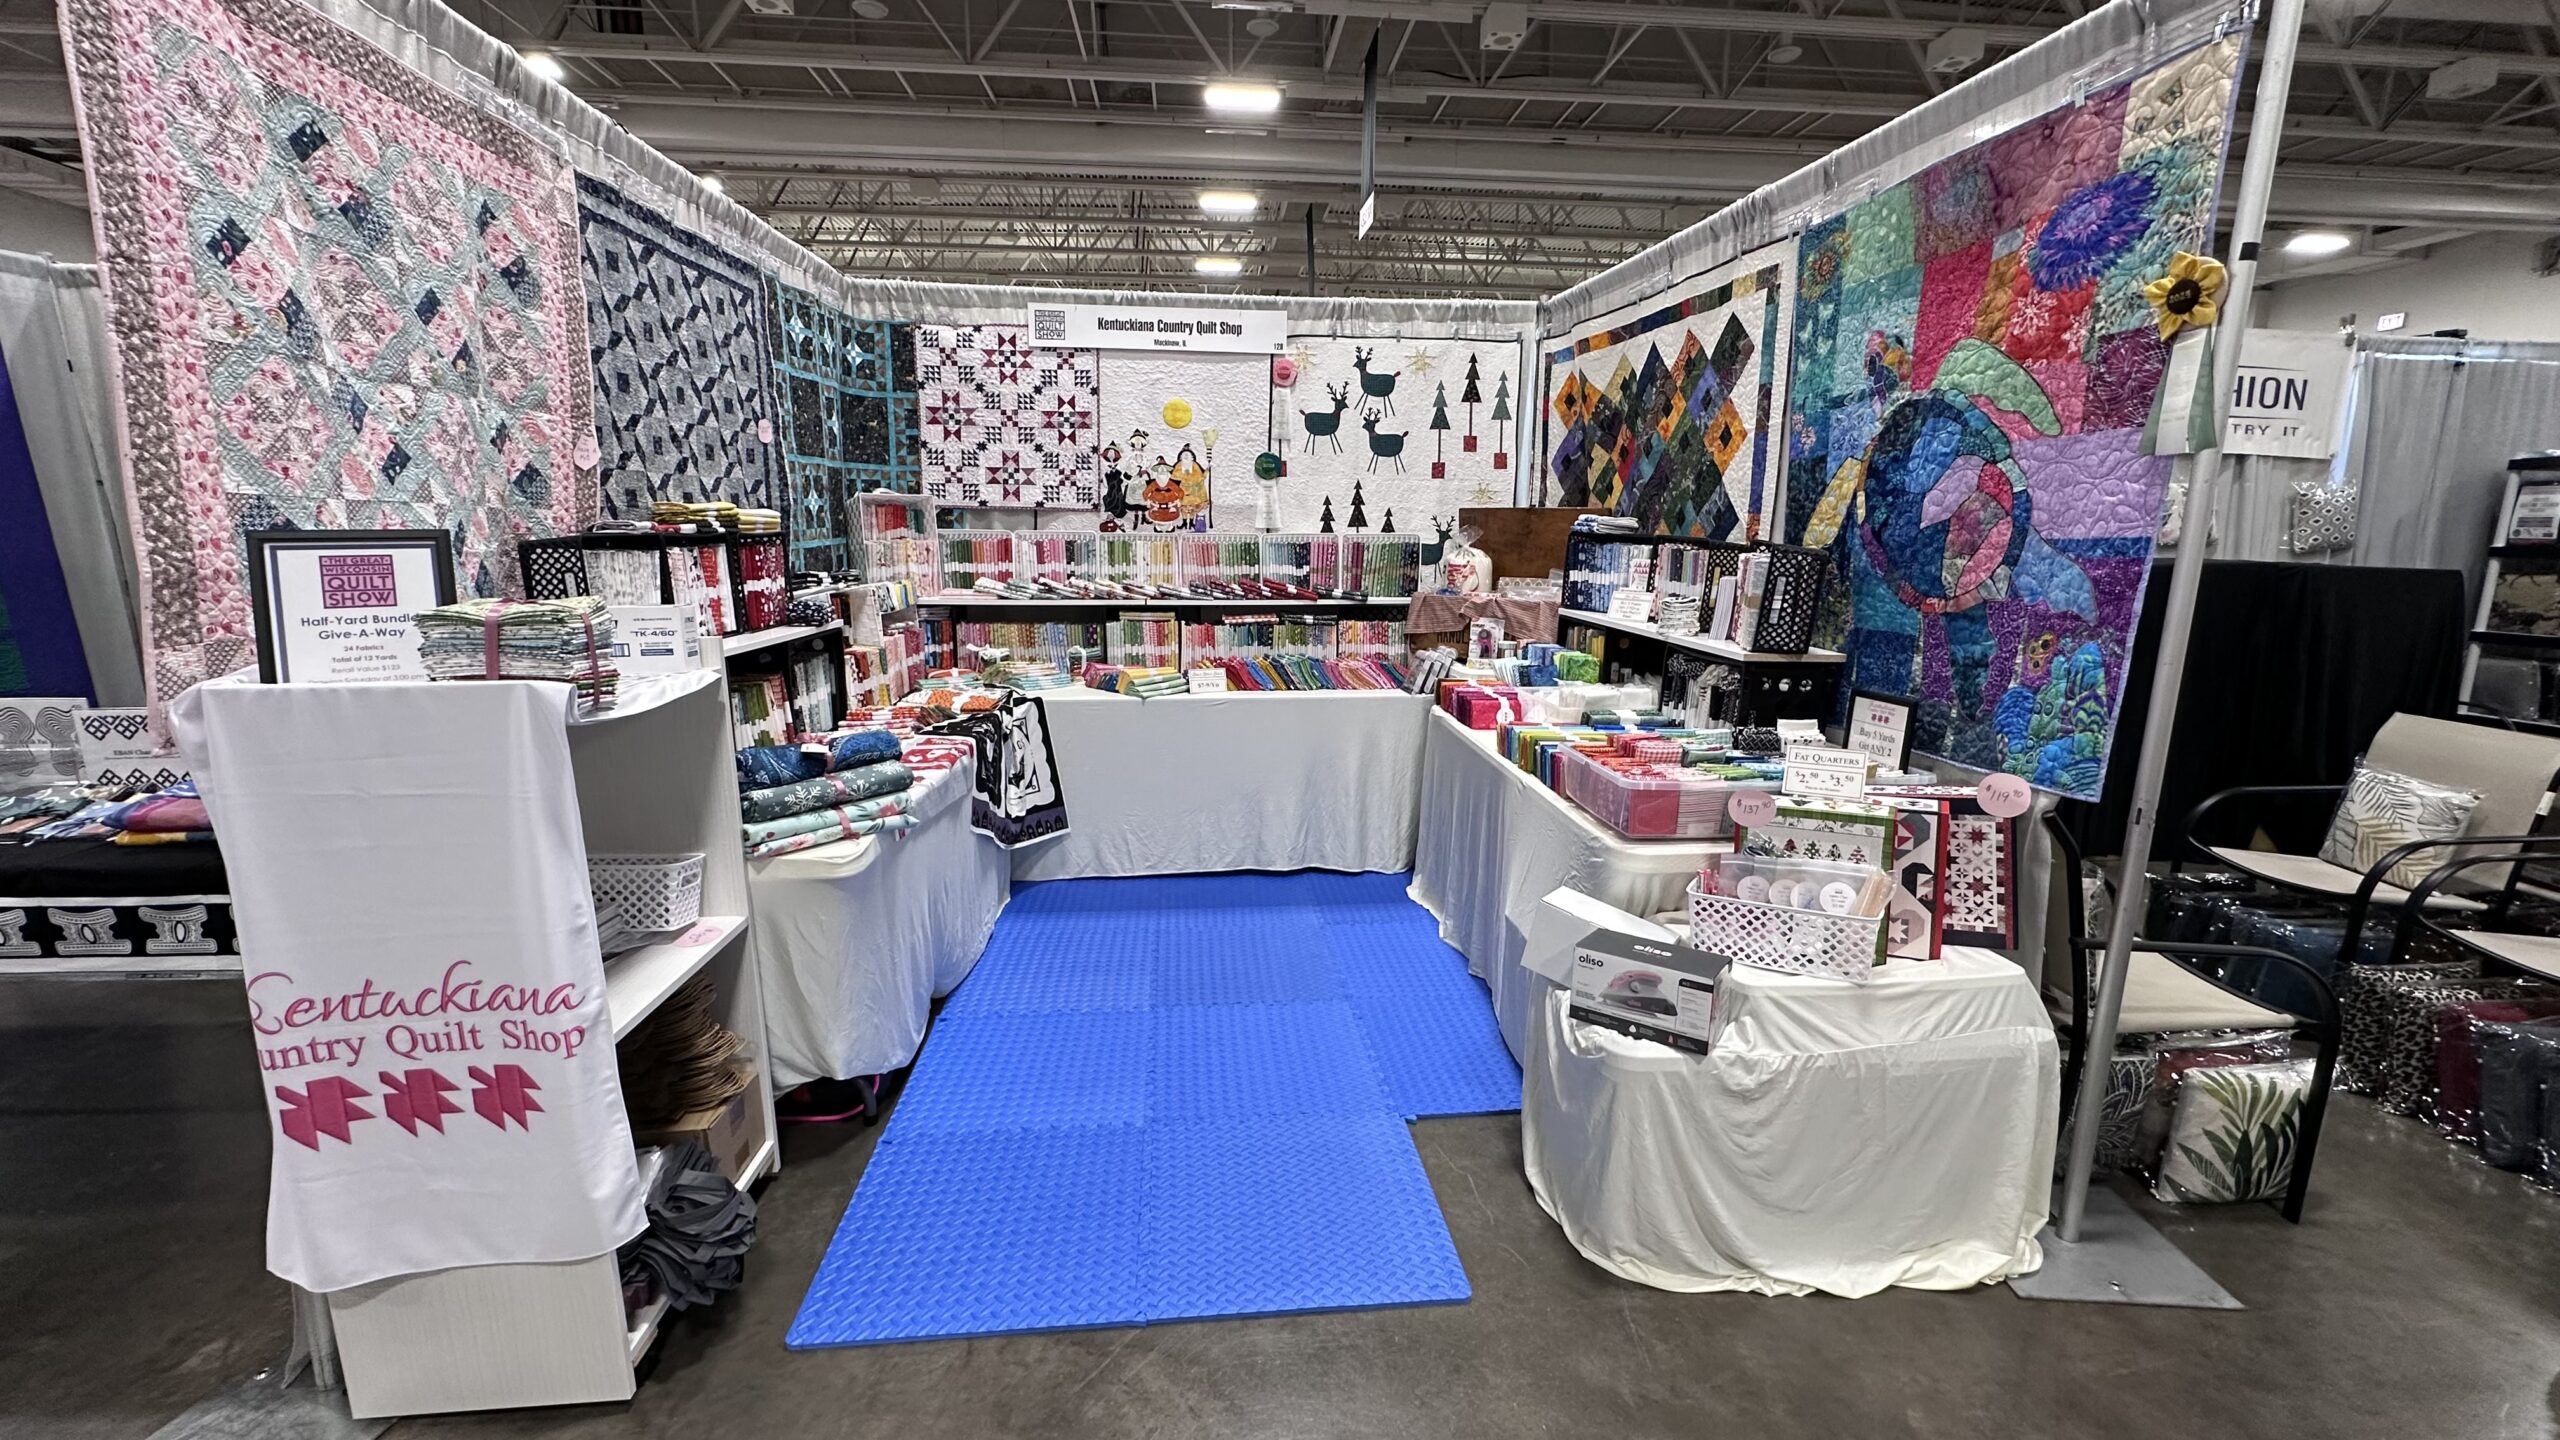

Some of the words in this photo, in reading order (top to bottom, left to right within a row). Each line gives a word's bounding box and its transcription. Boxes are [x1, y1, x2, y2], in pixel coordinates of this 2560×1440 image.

[1097, 317, 1154, 332] Kentuckiana
[1157, 319, 1193, 335] Country
[1196, 321, 1217, 335] Quilt
[1220, 322, 1242, 337] Shop
[2232, 424, 2270, 435] TRY
[2283, 426, 2299, 437] IT
[325, 566, 390, 574] WISCONSIN
[327, 575, 390, 590] QUILT
[328, 591, 392, 606] SHOW
[301, 615, 368, 627] Half-Yard
[319, 628, 406, 640] Give-A-Way
[1879, 732, 1895, 743] Yards
[1812, 753, 1859, 765] QUARTERS
[1887, 748, 1892, 757] 2
[1633, 944, 1672, 957] oliso
[1579, 954, 1604, 967] oliso
[386, 1021, 484, 1060] Quilt
[500, 1019, 586, 1059] Shop
